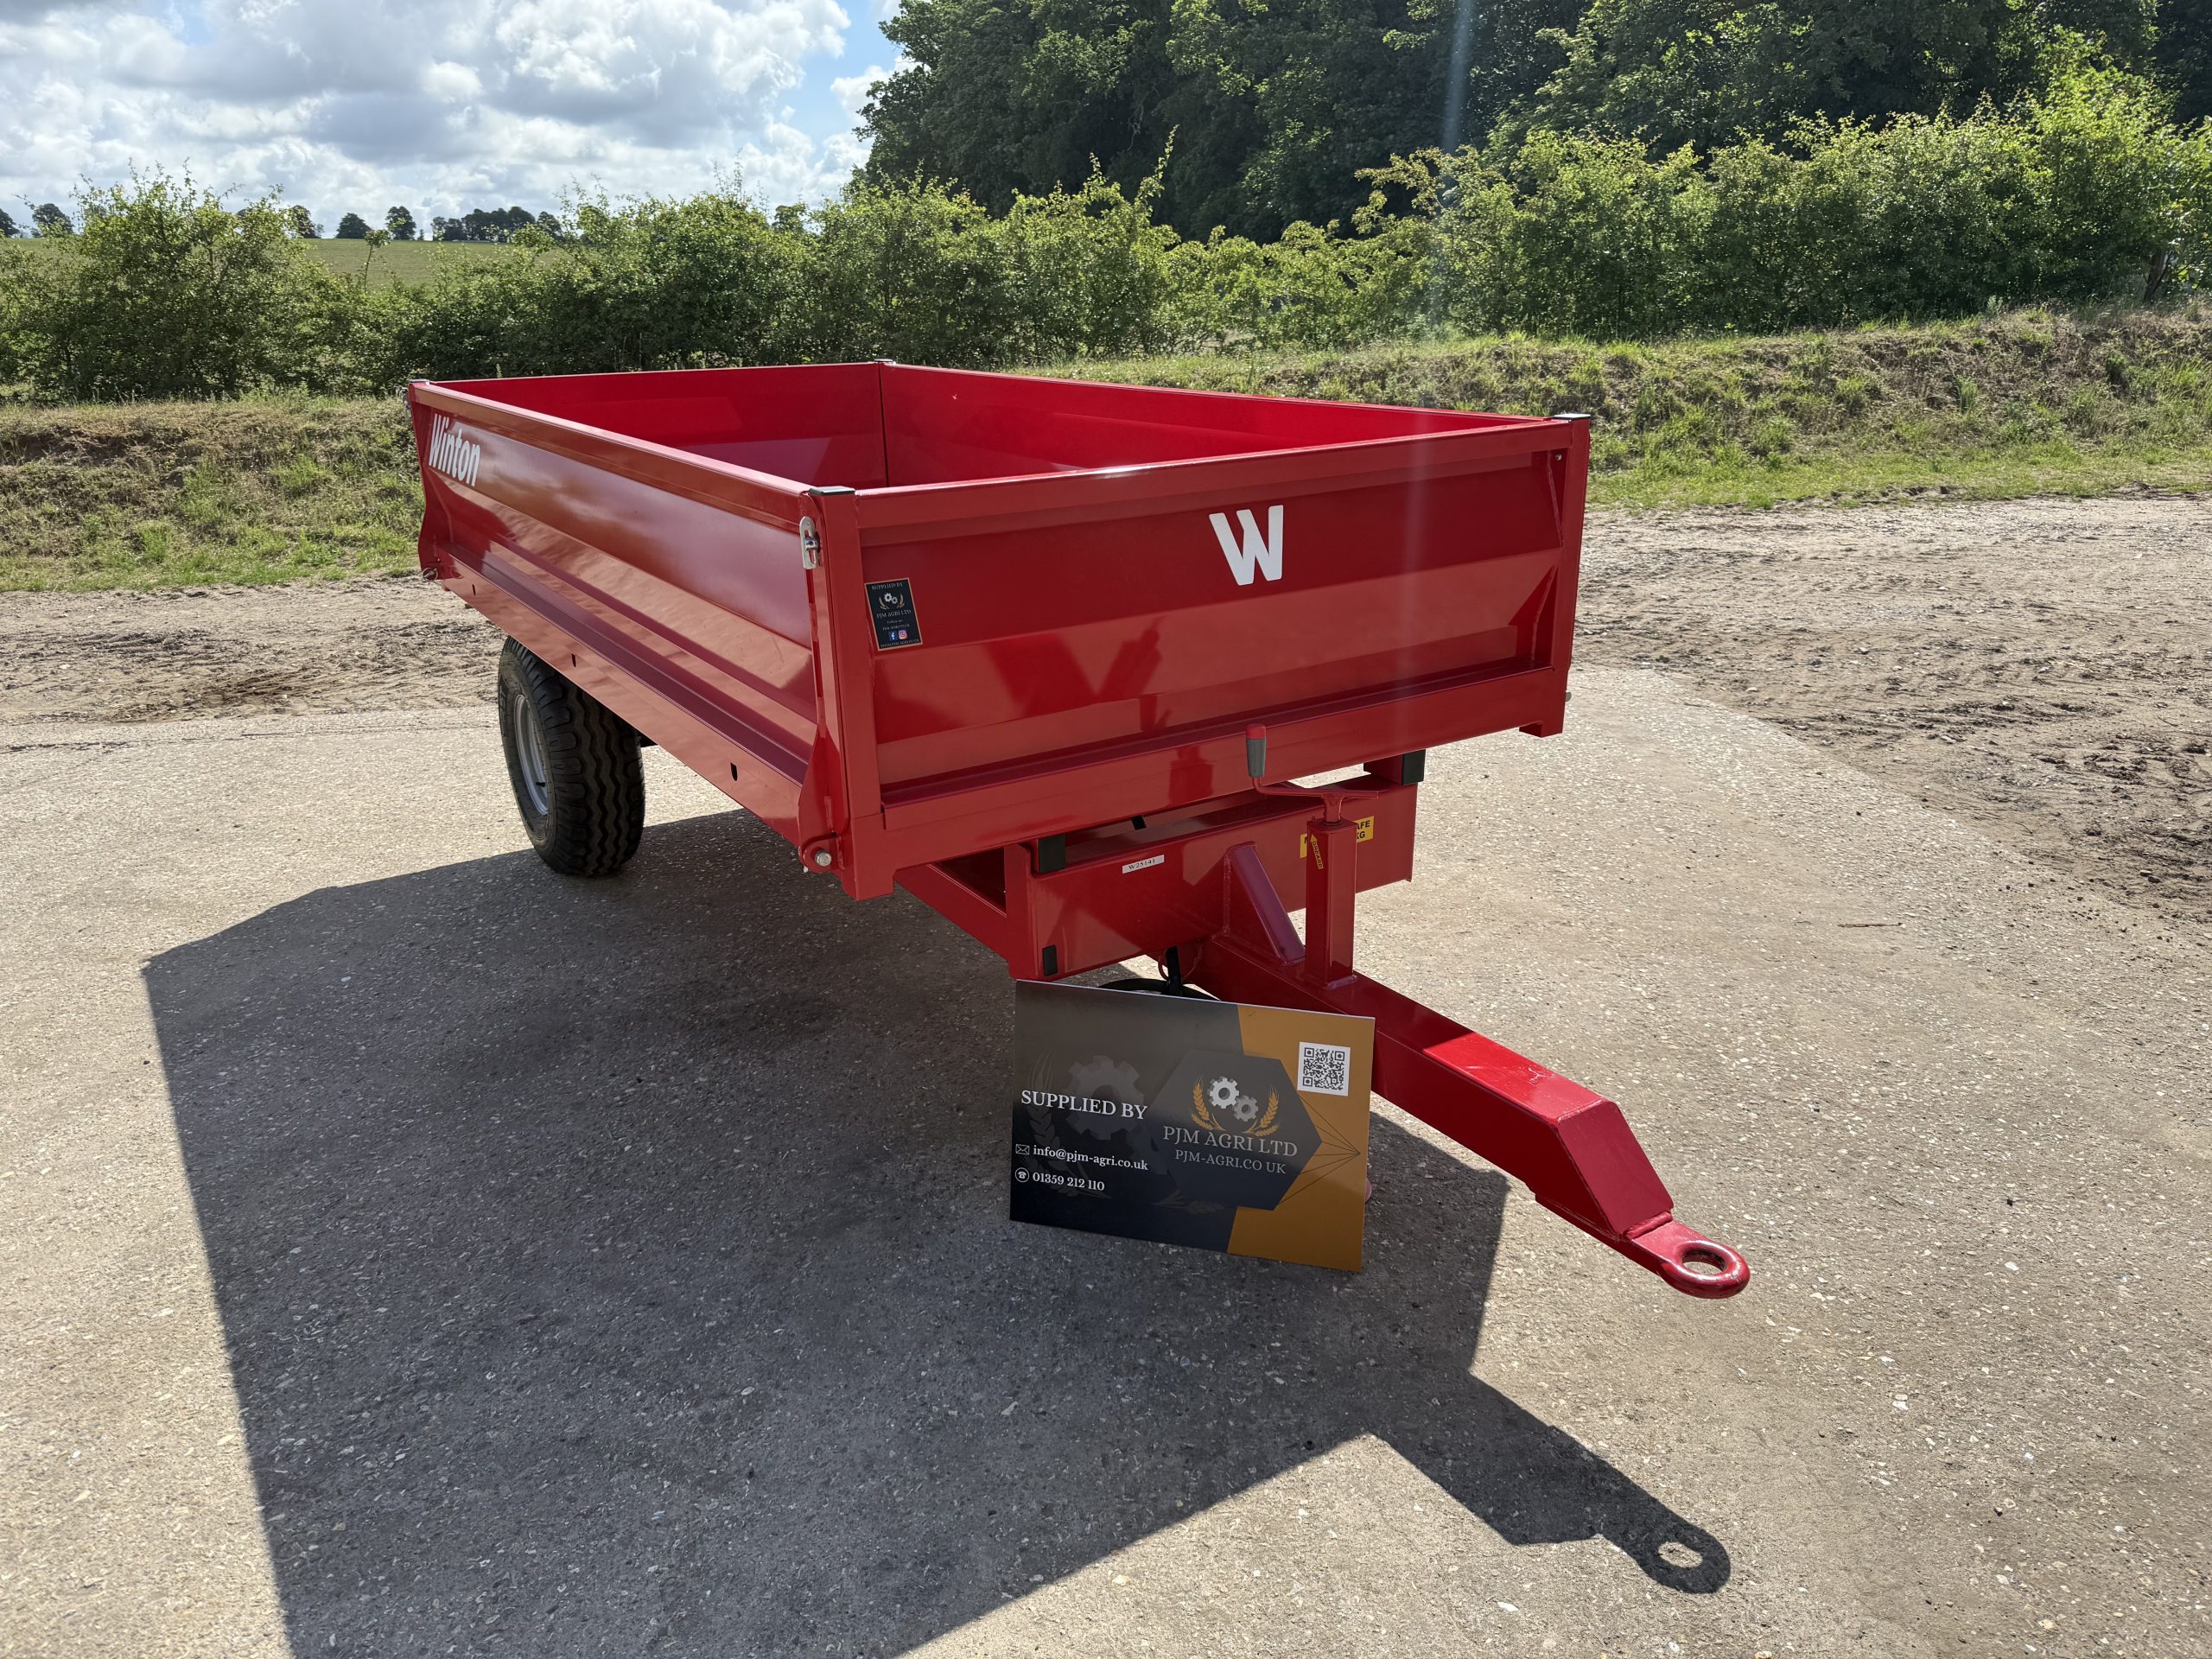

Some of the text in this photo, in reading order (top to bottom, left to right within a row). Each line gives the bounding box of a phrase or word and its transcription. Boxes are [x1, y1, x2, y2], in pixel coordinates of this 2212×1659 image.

[428, 413, 480, 487] Winton
[1209, 505, 1284, 586] W
[1313, 841, 1323, 868] GREASE
[1021, 1090, 1147, 1120] SUPPLIED BY
[1163, 1125, 1298, 1157] PJM AGRI LTD
[1033, 1145, 1148, 1171] info@pjm-agri.co.uk
[1033, 1172, 1105, 1192] 01359 212 110
